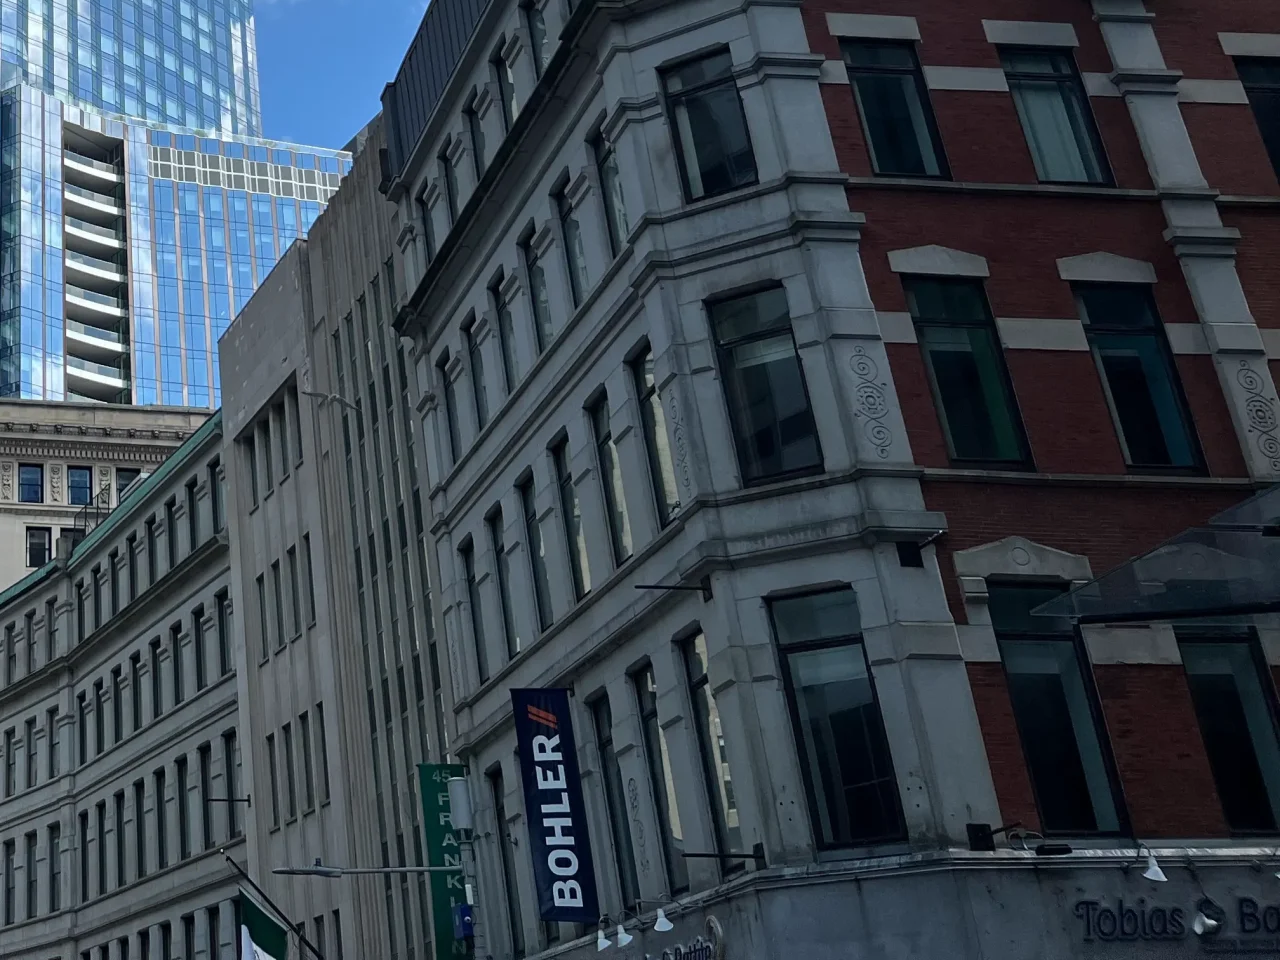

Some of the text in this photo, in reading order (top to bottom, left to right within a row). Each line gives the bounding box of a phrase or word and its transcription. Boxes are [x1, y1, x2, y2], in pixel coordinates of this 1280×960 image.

[432, 770, 452, 783] 45
[532, 734, 584, 908] BOHLER
[1075, 898, 1186, 938] Tobias
